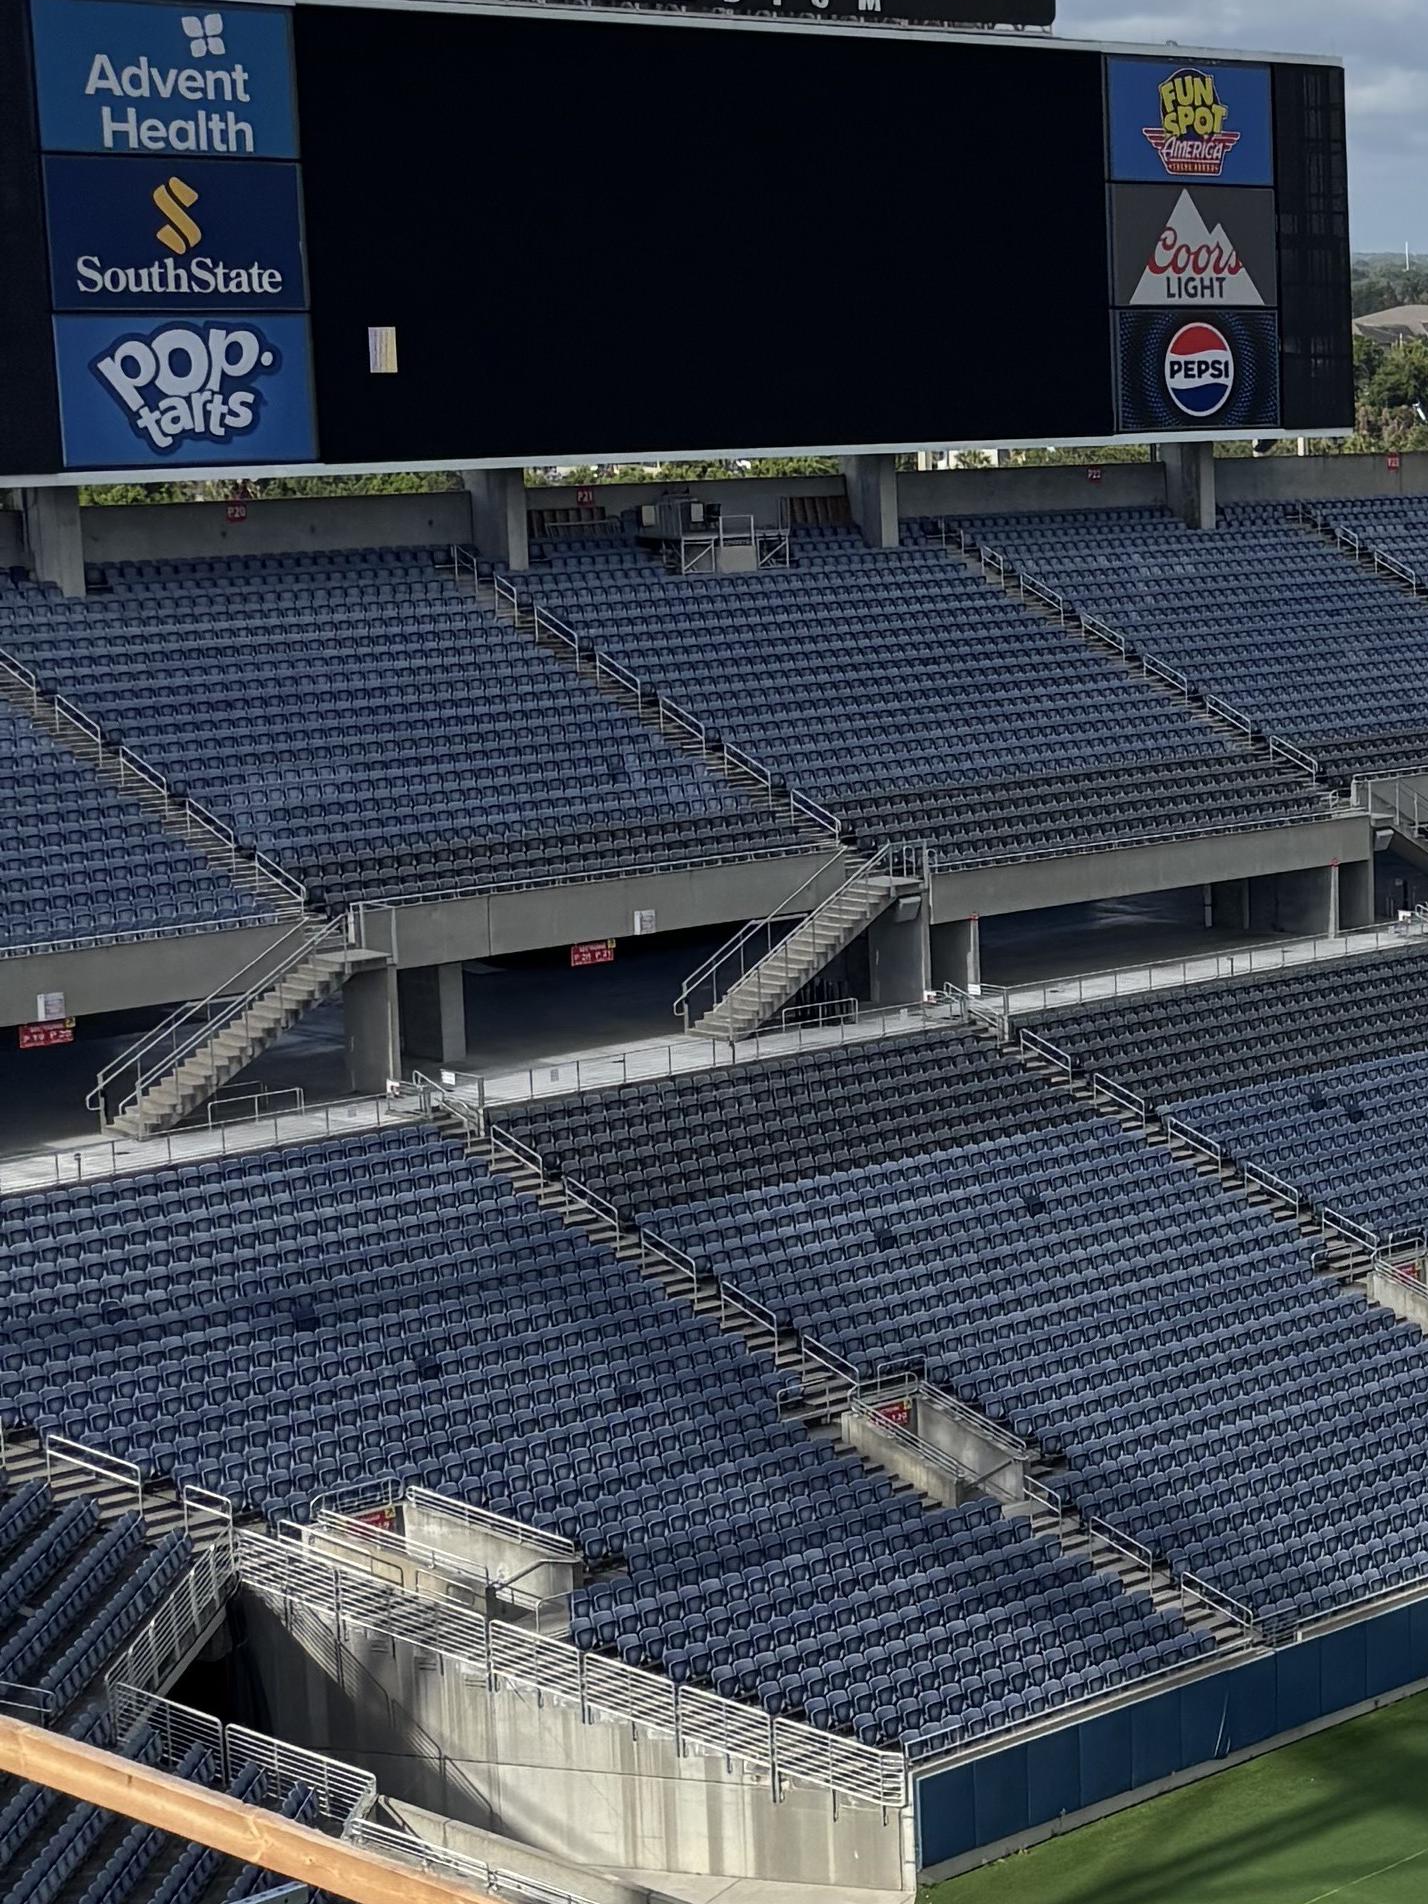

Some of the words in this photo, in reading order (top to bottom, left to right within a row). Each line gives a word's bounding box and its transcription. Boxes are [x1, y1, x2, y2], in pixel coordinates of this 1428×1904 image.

[85, 53, 251, 103] Advent
[1160, 75, 1214, 113] FUN
[101, 105, 254, 153] Health
[1163, 104, 1228, 137] SPOT
[1161, 136, 1223, 161] AMERICA
[1146, 226, 1244, 276] Coors
[76, 255, 283, 295] SouthState
[1166, 276, 1227, 299] LIGHT
[1169, 359, 1230, 380] PEPSI
[136, 389, 255, 449] tarts
[227, 506, 246, 518] P20
[578, 490, 593, 503] P21
